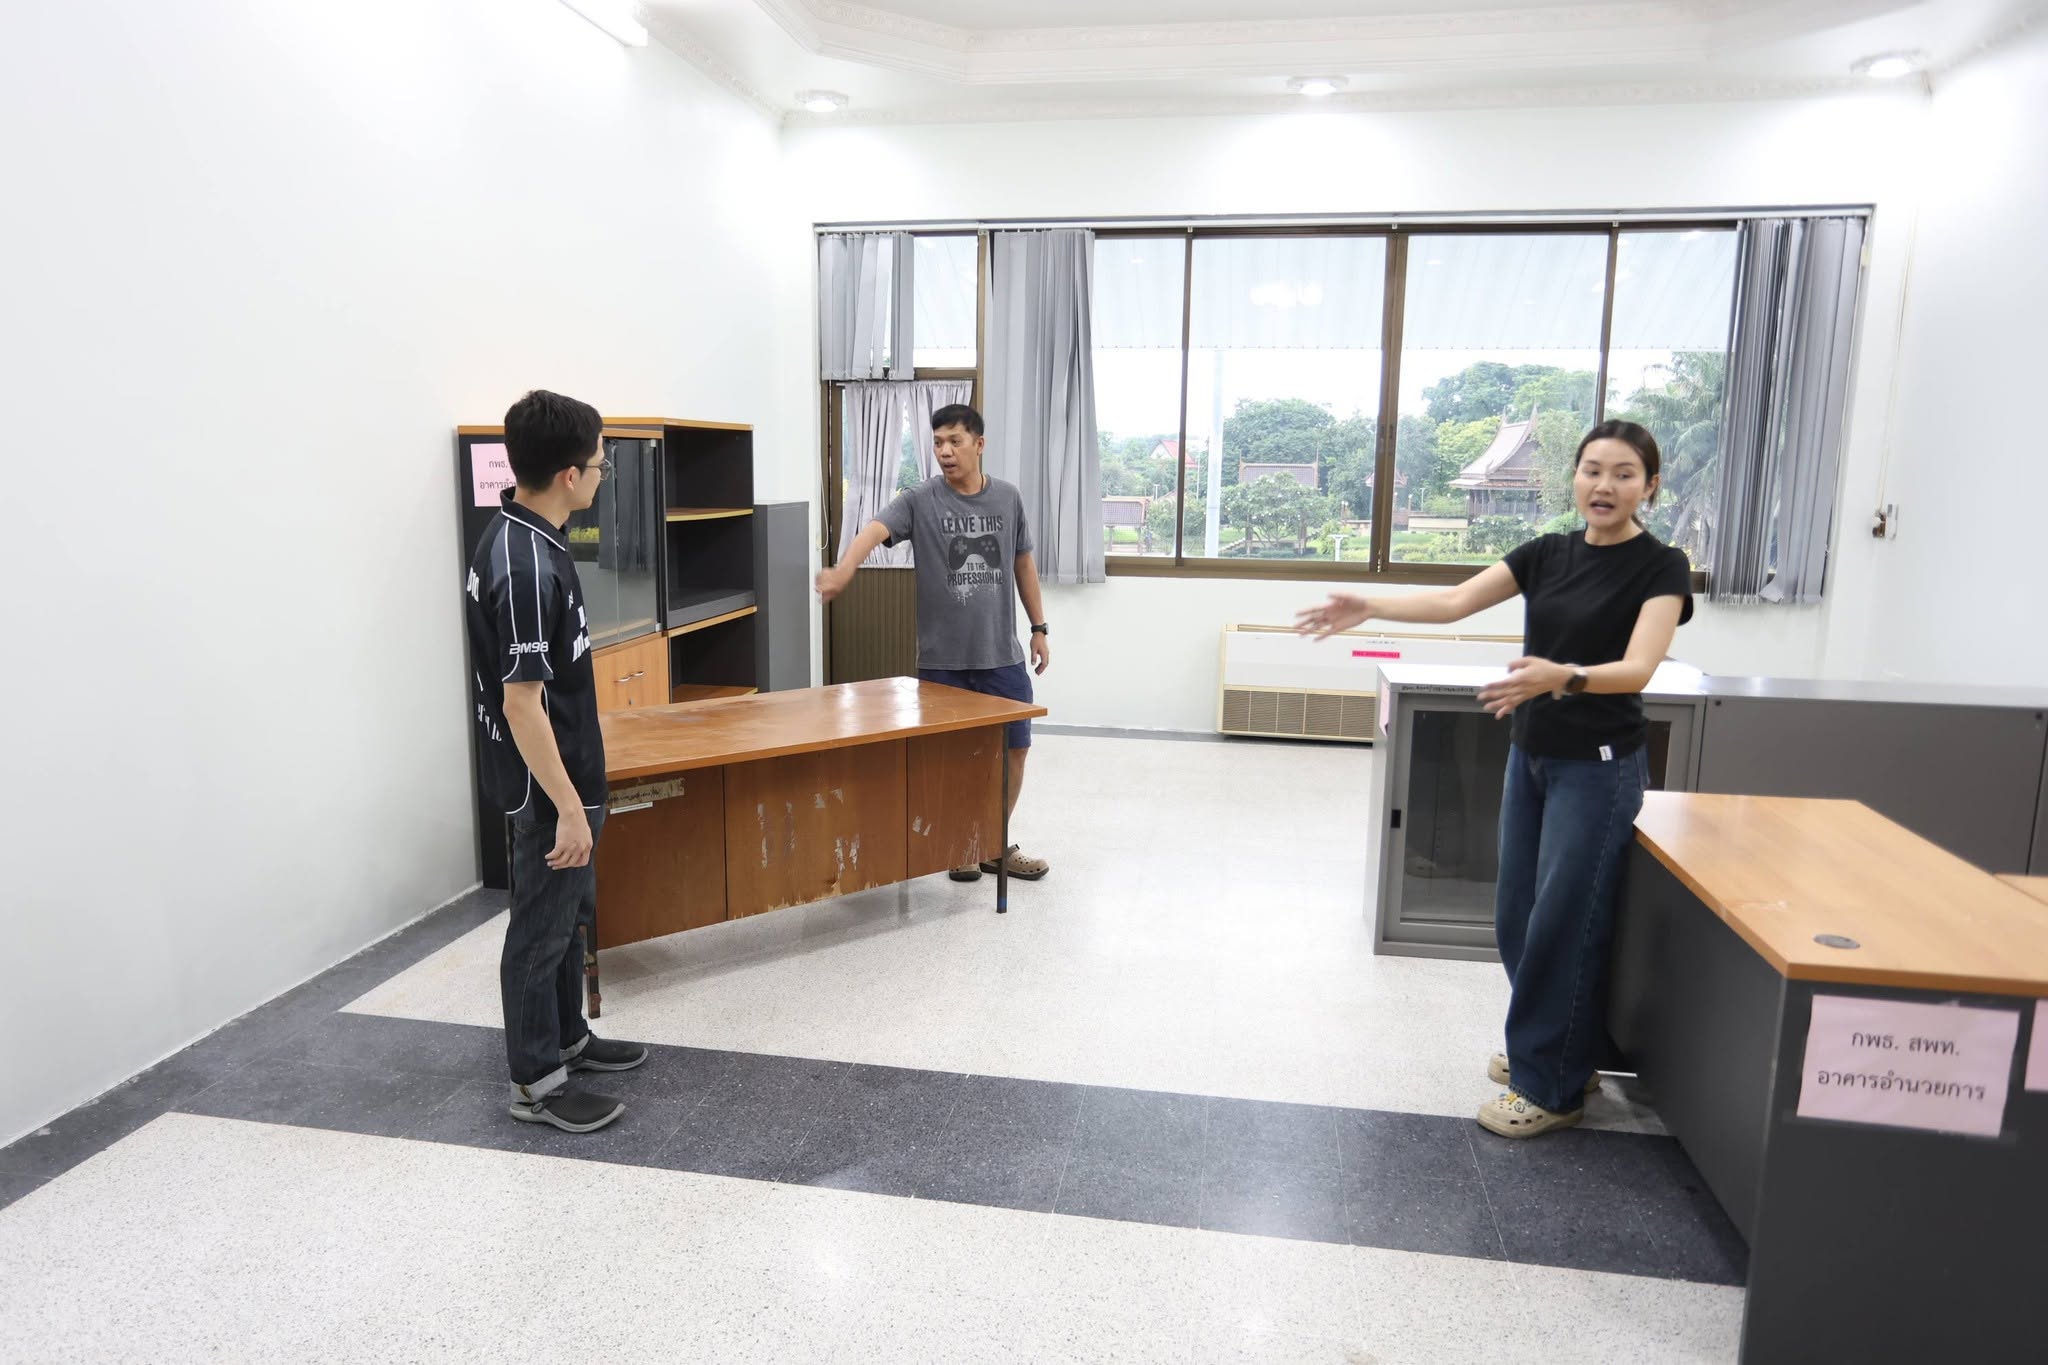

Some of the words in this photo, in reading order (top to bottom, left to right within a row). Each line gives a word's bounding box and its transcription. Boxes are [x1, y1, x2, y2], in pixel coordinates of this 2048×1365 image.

[942, 517, 975, 534] LEAVE
[978, 515, 1003, 532] THIS
[967, 562, 974, 571] TO
[975, 562, 985, 571] THE
[947, 572, 1003, 586] PROFESSIONAL
[509, 641, 549, 655] BM98
[1851, 1030, 1899, 1051] กพธ.
[1909, 1035, 1960, 1056] สพท.
[1817, 1070, 1986, 1101] อาคารอำนวยการ
